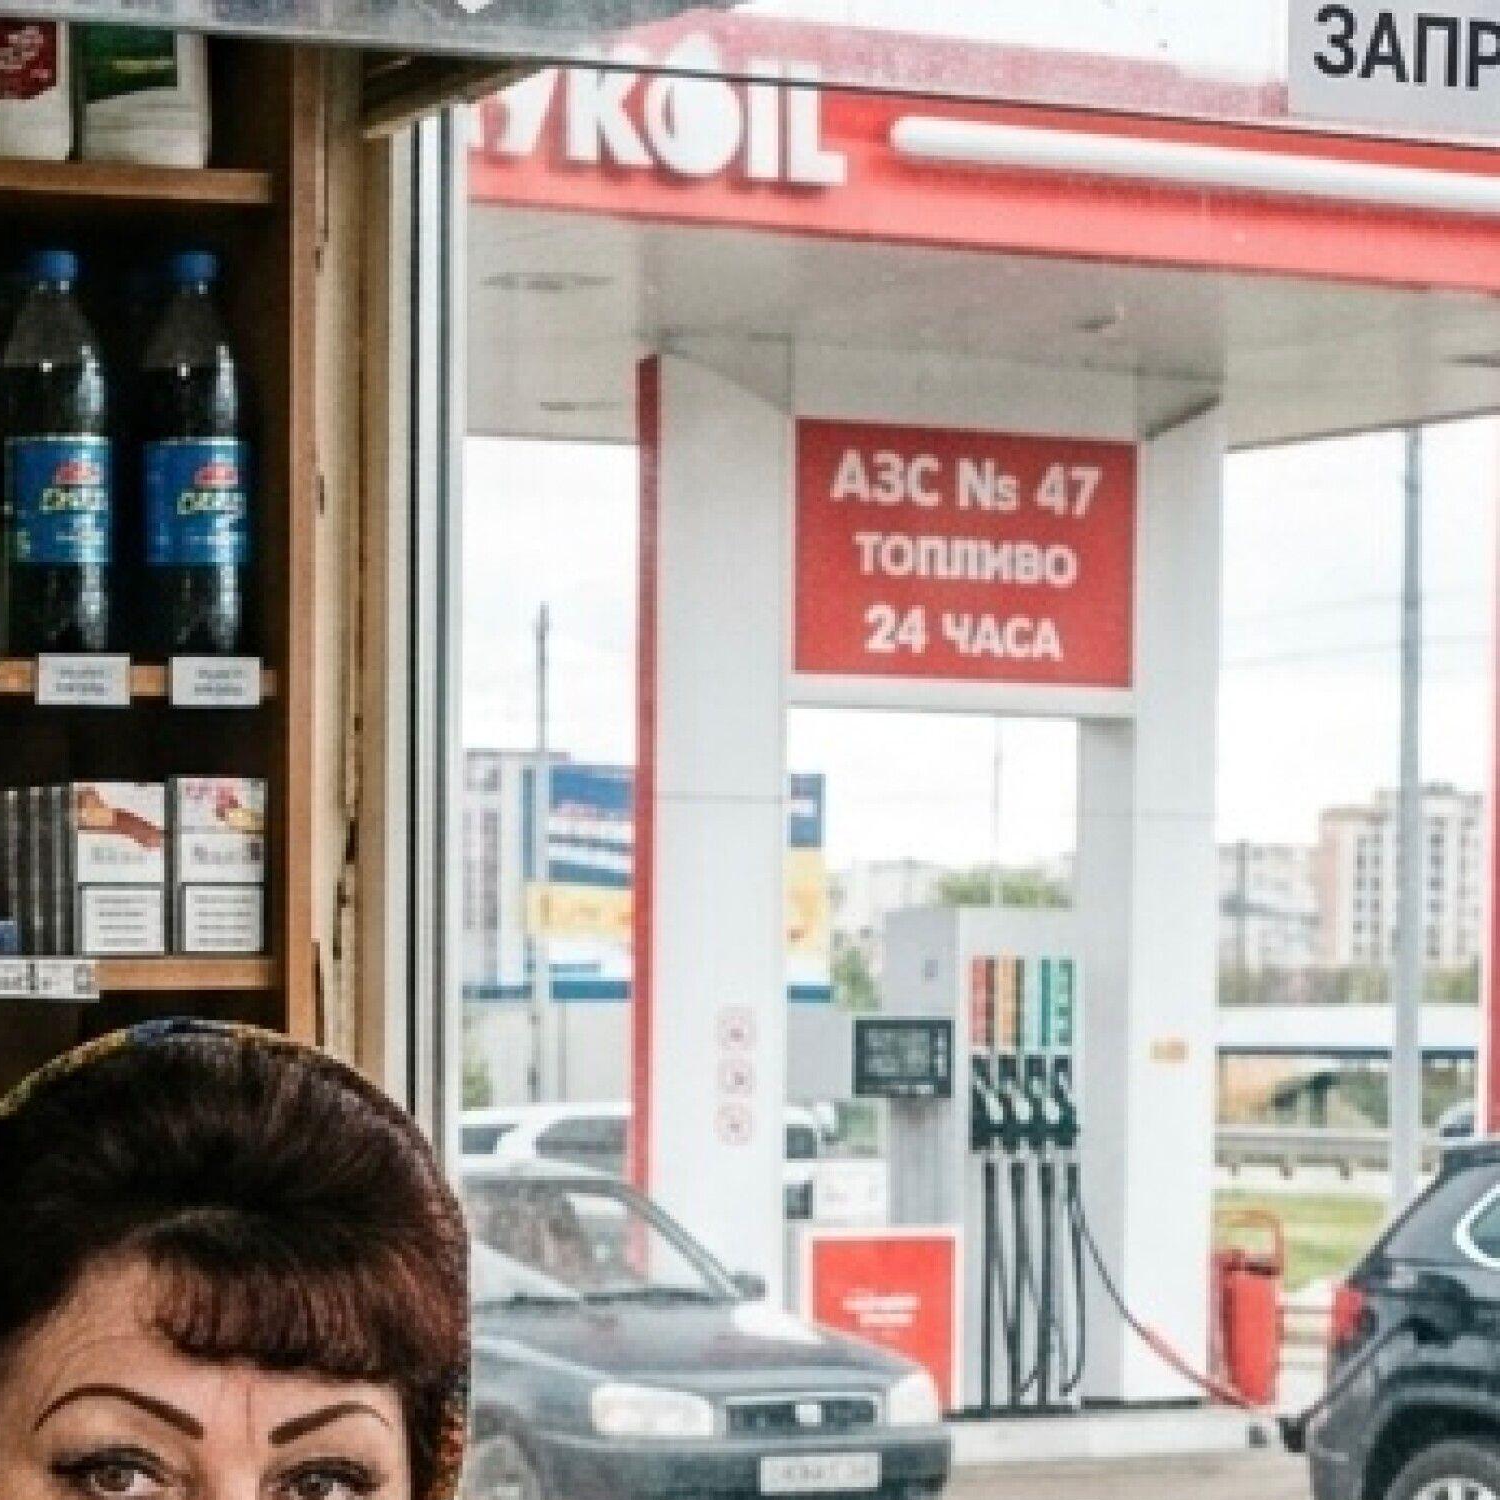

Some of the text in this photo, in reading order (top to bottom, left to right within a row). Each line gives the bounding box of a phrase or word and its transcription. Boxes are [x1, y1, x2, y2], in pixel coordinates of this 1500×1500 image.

[830, 448, 942, 509] АЗС
[1034, 461, 1103, 519] 47
[852, 530, 1078, 589] ТОПЛИВО
[863, 602, 1064, 662] 24 ЧАСА
